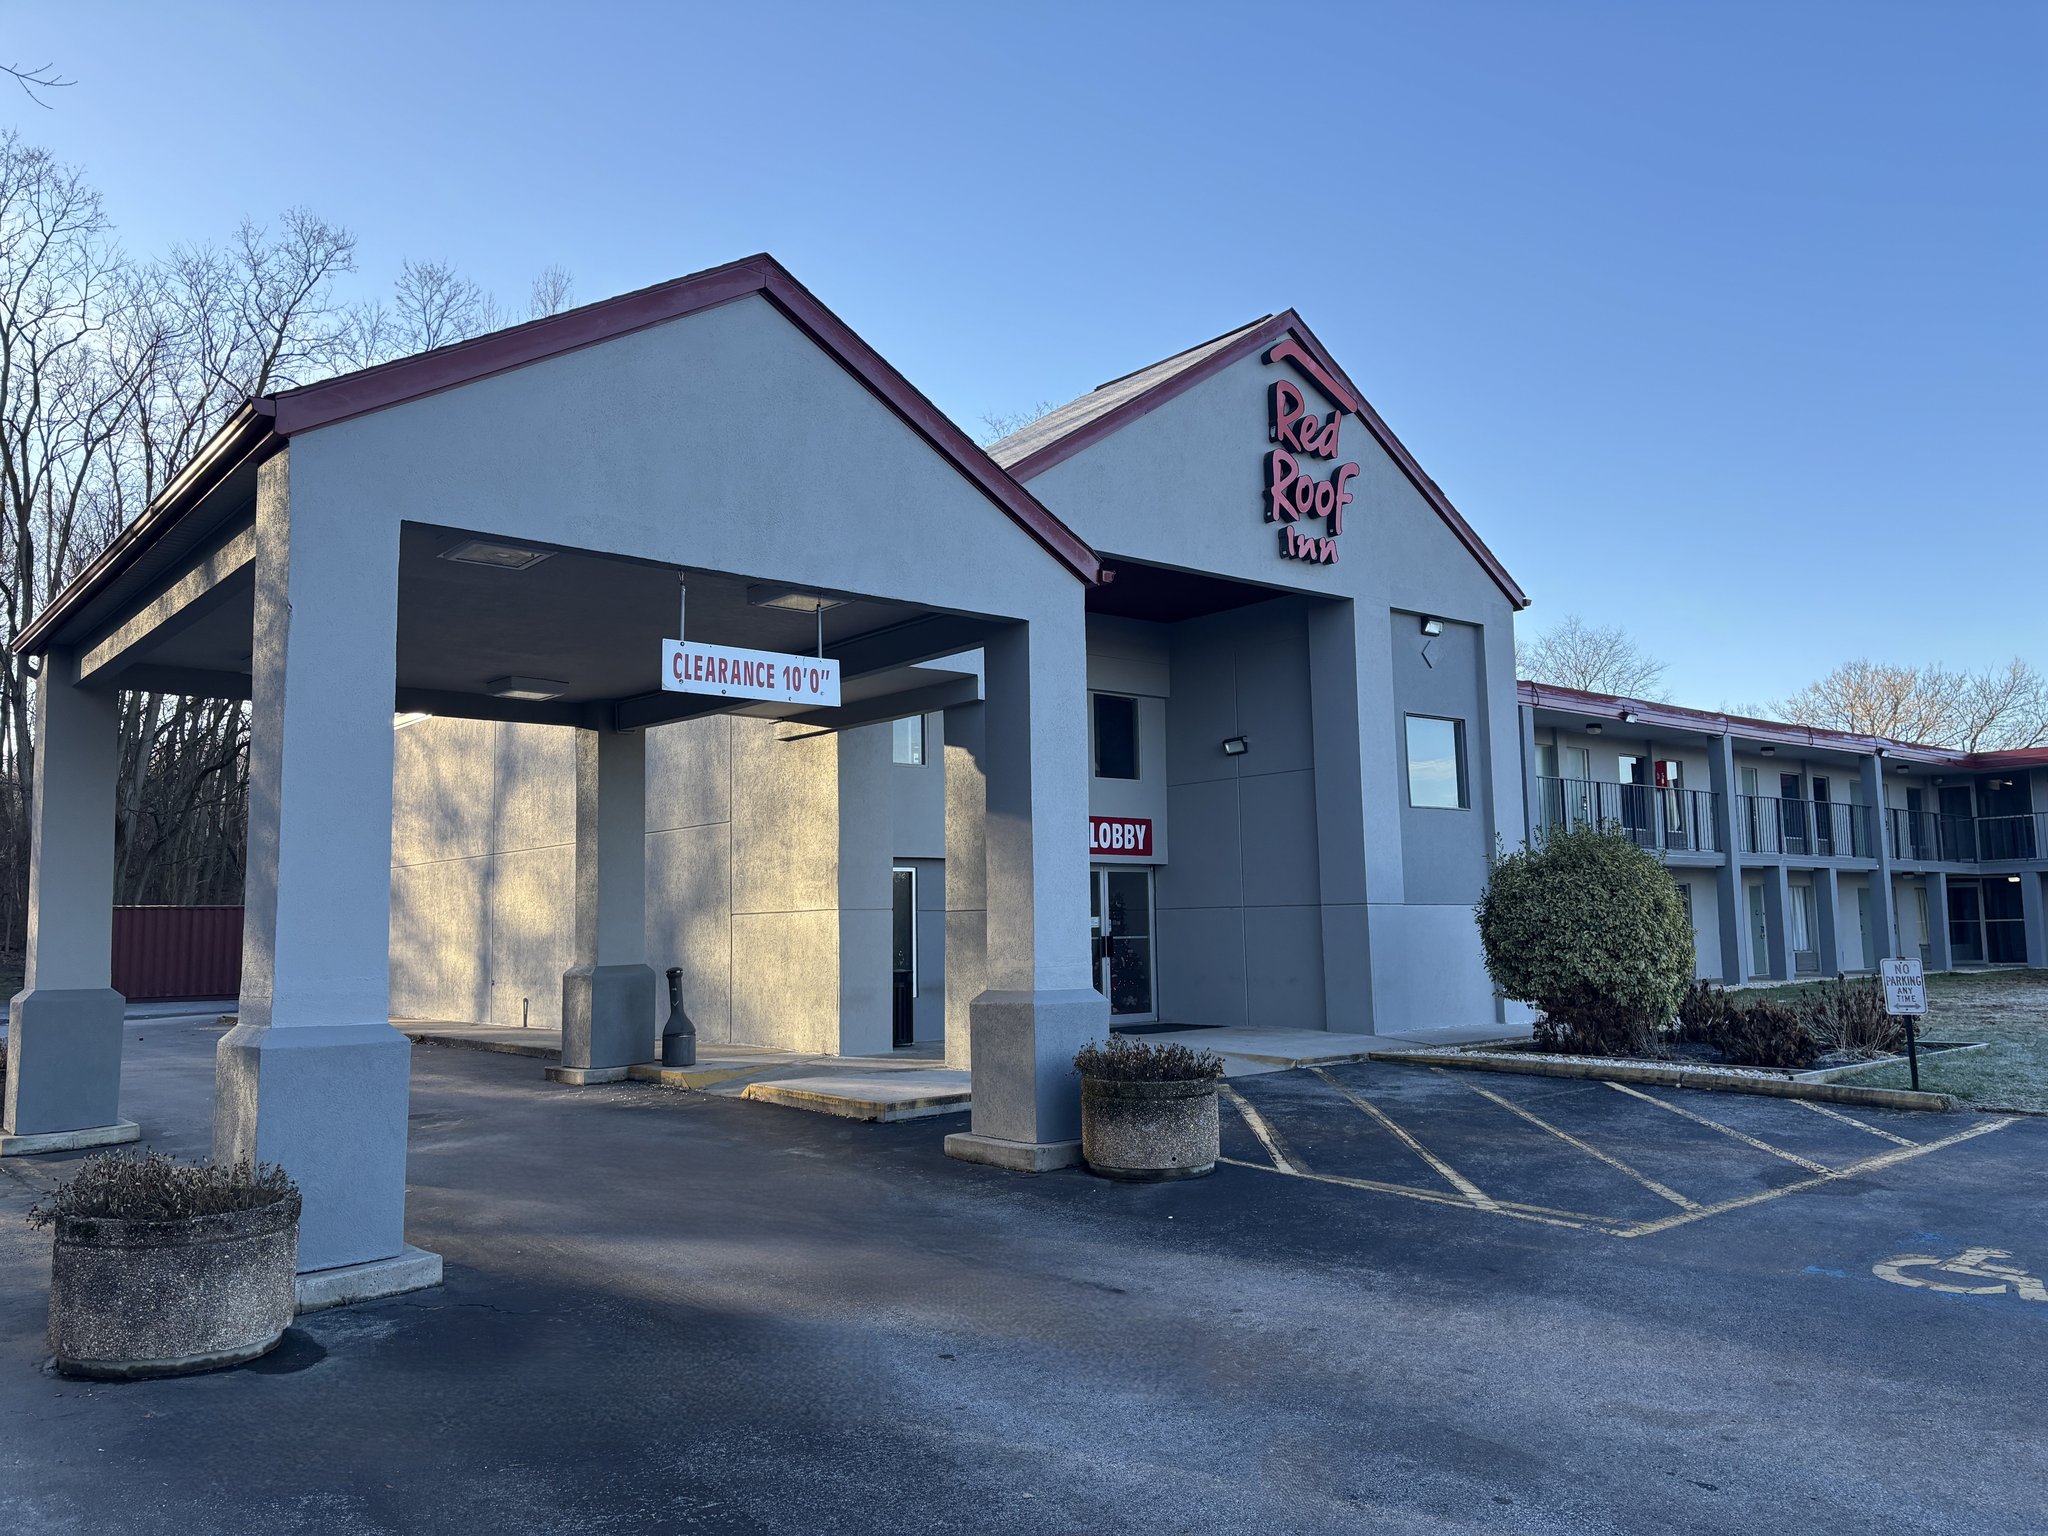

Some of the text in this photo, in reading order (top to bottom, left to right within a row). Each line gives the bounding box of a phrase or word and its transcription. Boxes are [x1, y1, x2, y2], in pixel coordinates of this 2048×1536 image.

[1275, 379, 1342, 459] Red
[1271, 448, 1360, 535] Roof
[672, 652, 775, 689] CLEARANCE
[1089, 822, 1146, 850] LOBBY
[1894, 963, 1910, 975] NO
[1885, 975, 1922, 987] PARKING
[1897, 986, 1913, 995] ANY
[1896, 995, 1917, 1003] TIME
